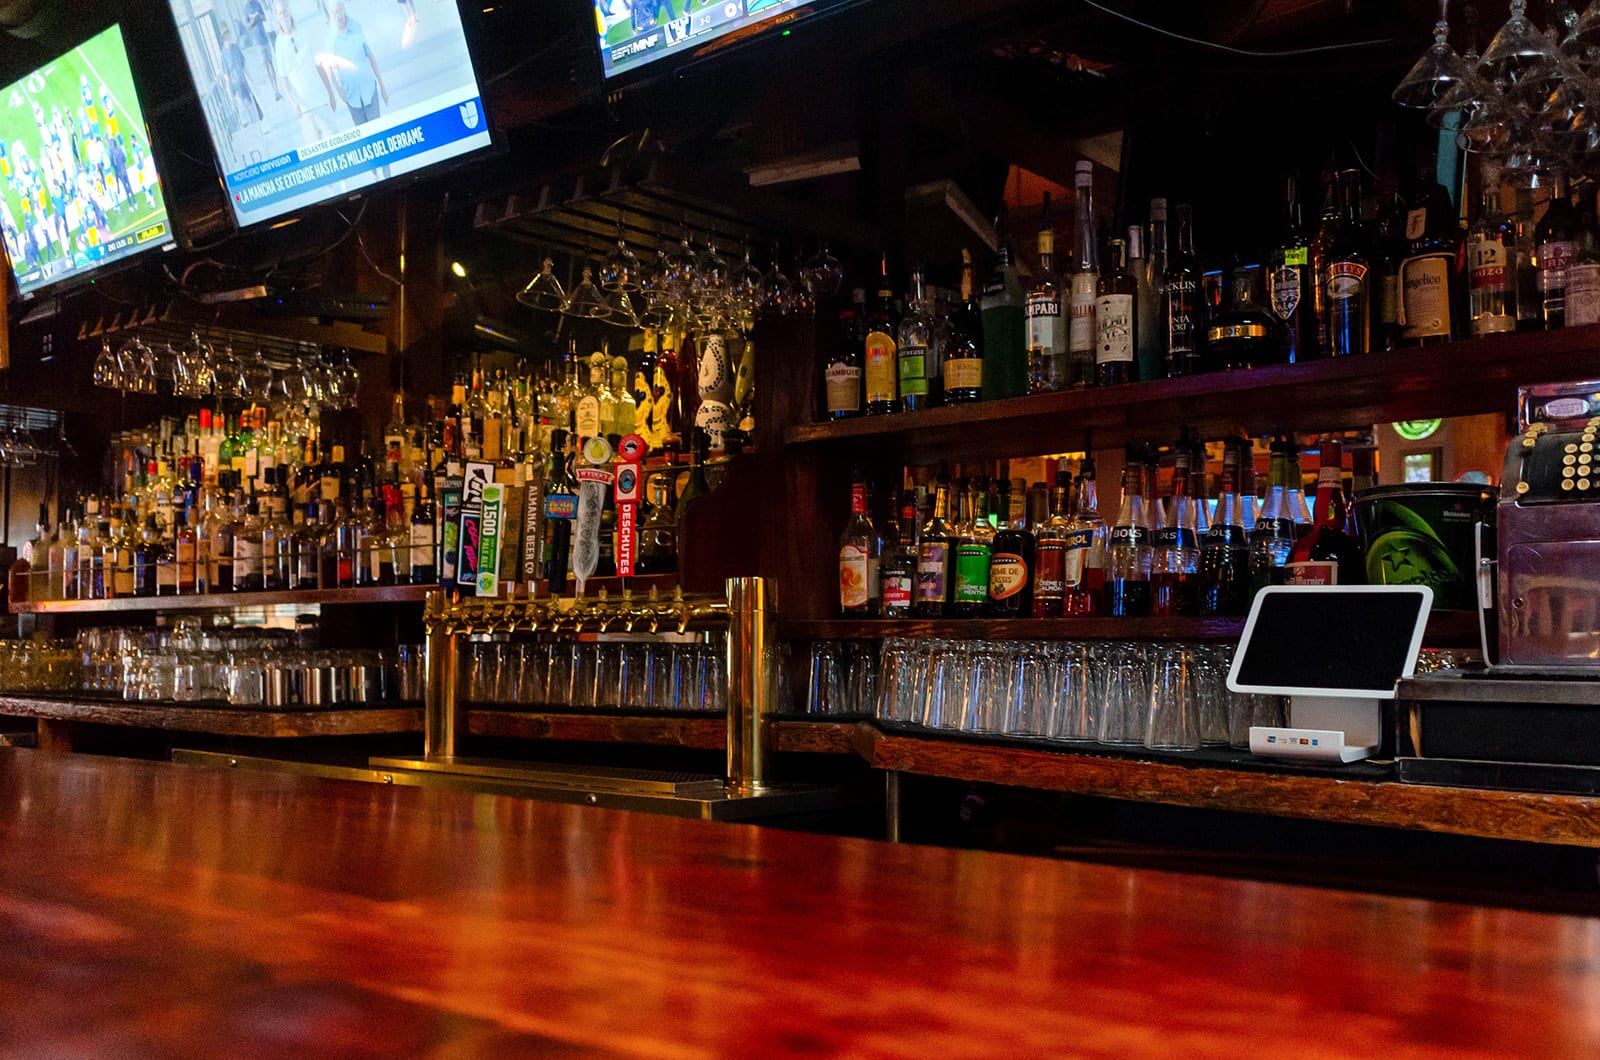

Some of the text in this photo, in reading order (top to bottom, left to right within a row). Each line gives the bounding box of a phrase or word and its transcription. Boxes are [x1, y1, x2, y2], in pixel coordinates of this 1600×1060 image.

[632, 34, 659, 54] MNF
[300, 140, 329, 158] DESASTRE
[248, 180, 276, 201] MANCHA
[275, 175, 285, 192] SE
[283, 165, 316, 190] EXTIENDE
[314, 154, 340, 178] HASTA
[339, 152, 349, 170] 25
[348, 144, 375, 167] MILLAS
[372, 140, 389, 158] DEL
[387, 126, 425, 153] DERRAME
[1477, 248, 1496, 266] 12
[1406, 272, 1441, 290] ngelico
[1024, 302, 1058, 318] AMPARI
[526, 485, 538, 533] ALMANAC
[482, 505, 498, 536] 1500
[620, 503, 632, 574] DESCHUTES
[1066, 534, 1088, 548] EROL
[1113, 529, 1143, 538] BOLS
[1159, 531, 1177, 540] OLS
[525, 534, 536, 560] BEER
[1009, 567, 1019, 575] DE
